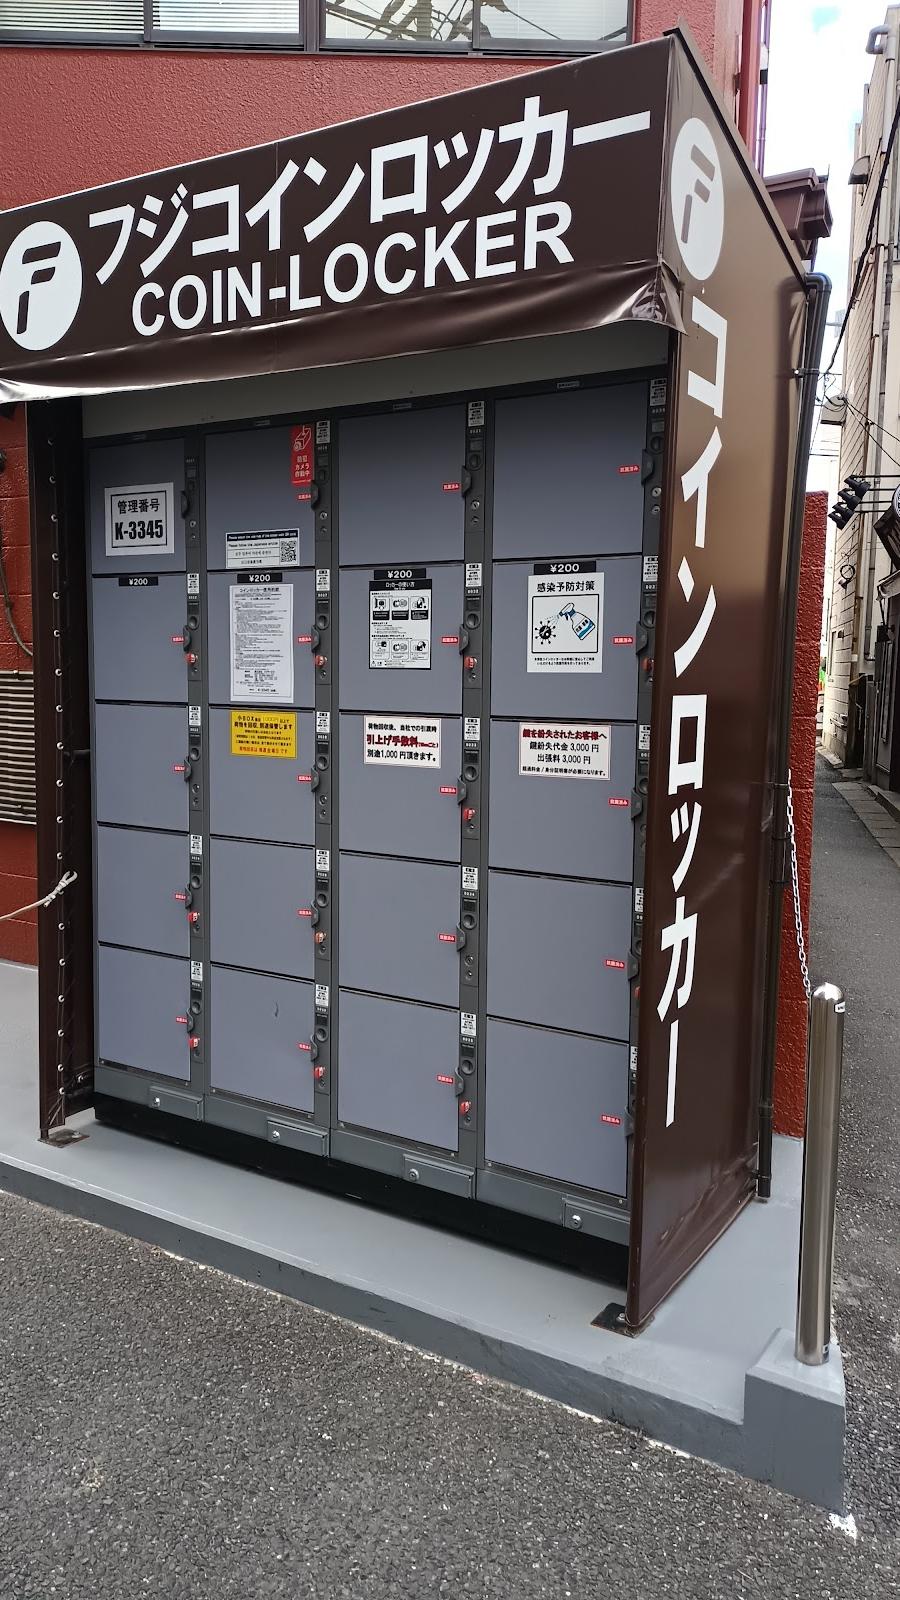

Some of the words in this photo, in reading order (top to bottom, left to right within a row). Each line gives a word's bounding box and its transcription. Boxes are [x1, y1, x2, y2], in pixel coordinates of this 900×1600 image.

[90, 96, 651, 285] フジコインロッカー
[133, 202, 575, 336] COIN-LOCKER
[117, 498, 160, 514] 管理番号
[115, 519, 164, 541] K-3345
[550, 563, 580, 573] ¥200
[249, 574, 271, 583] ¥200
[387, 570, 413, 579] ¥200
[128, 577, 148, 586] ¥200
[536, 581, 596, 593] 感染予防対策
[656, 296, 728, 1128] コインロッカー
[522, 728, 608, 741] 鍵を紛失されたお客様へ
[570, 744, 590, 753] 3,000
[591, 744, 600, 753] 円
[537, 753, 561, 763] 出張料
[562, 755, 582, 764] 3,000
[583, 755, 591, 764] 円
